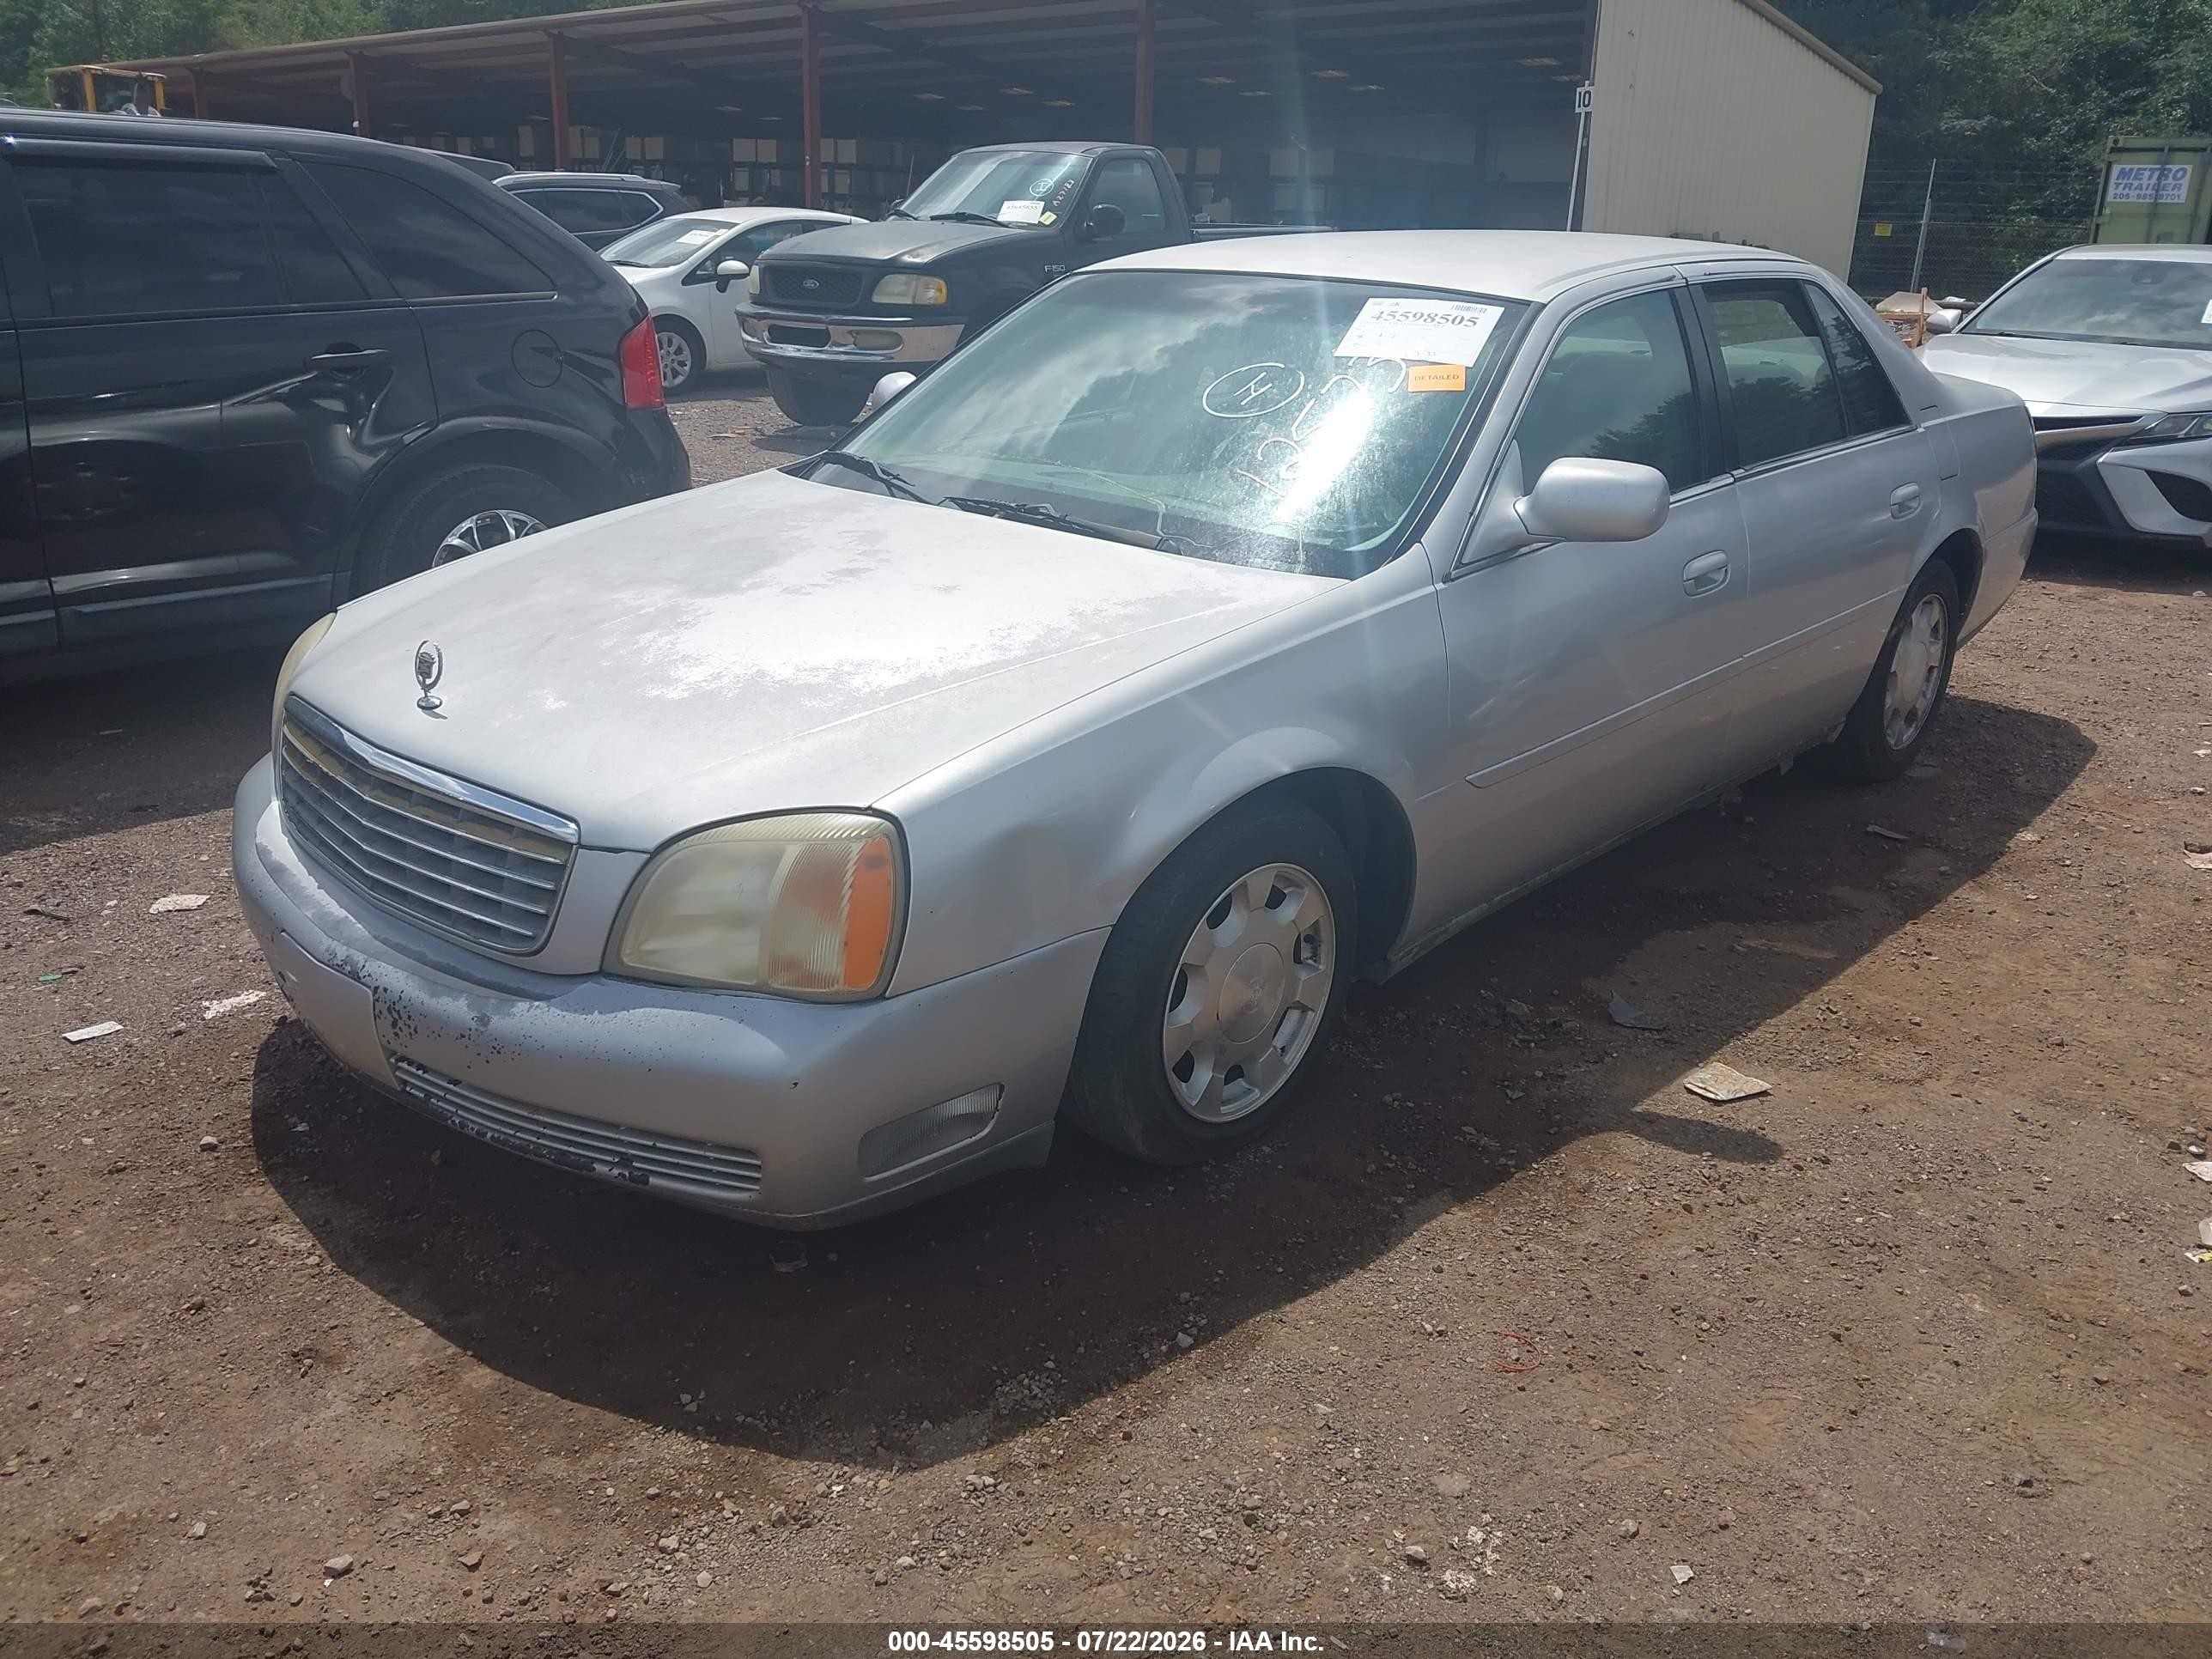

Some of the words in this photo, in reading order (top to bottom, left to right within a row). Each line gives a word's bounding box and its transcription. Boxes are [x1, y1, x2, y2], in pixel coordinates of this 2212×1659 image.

[1577, 90, 1592, 108] 10
[2115, 167, 2188, 182] METRO
[2112, 182, 2184, 191] TRAILER
[1370, 310, 1480, 328] 45598505
